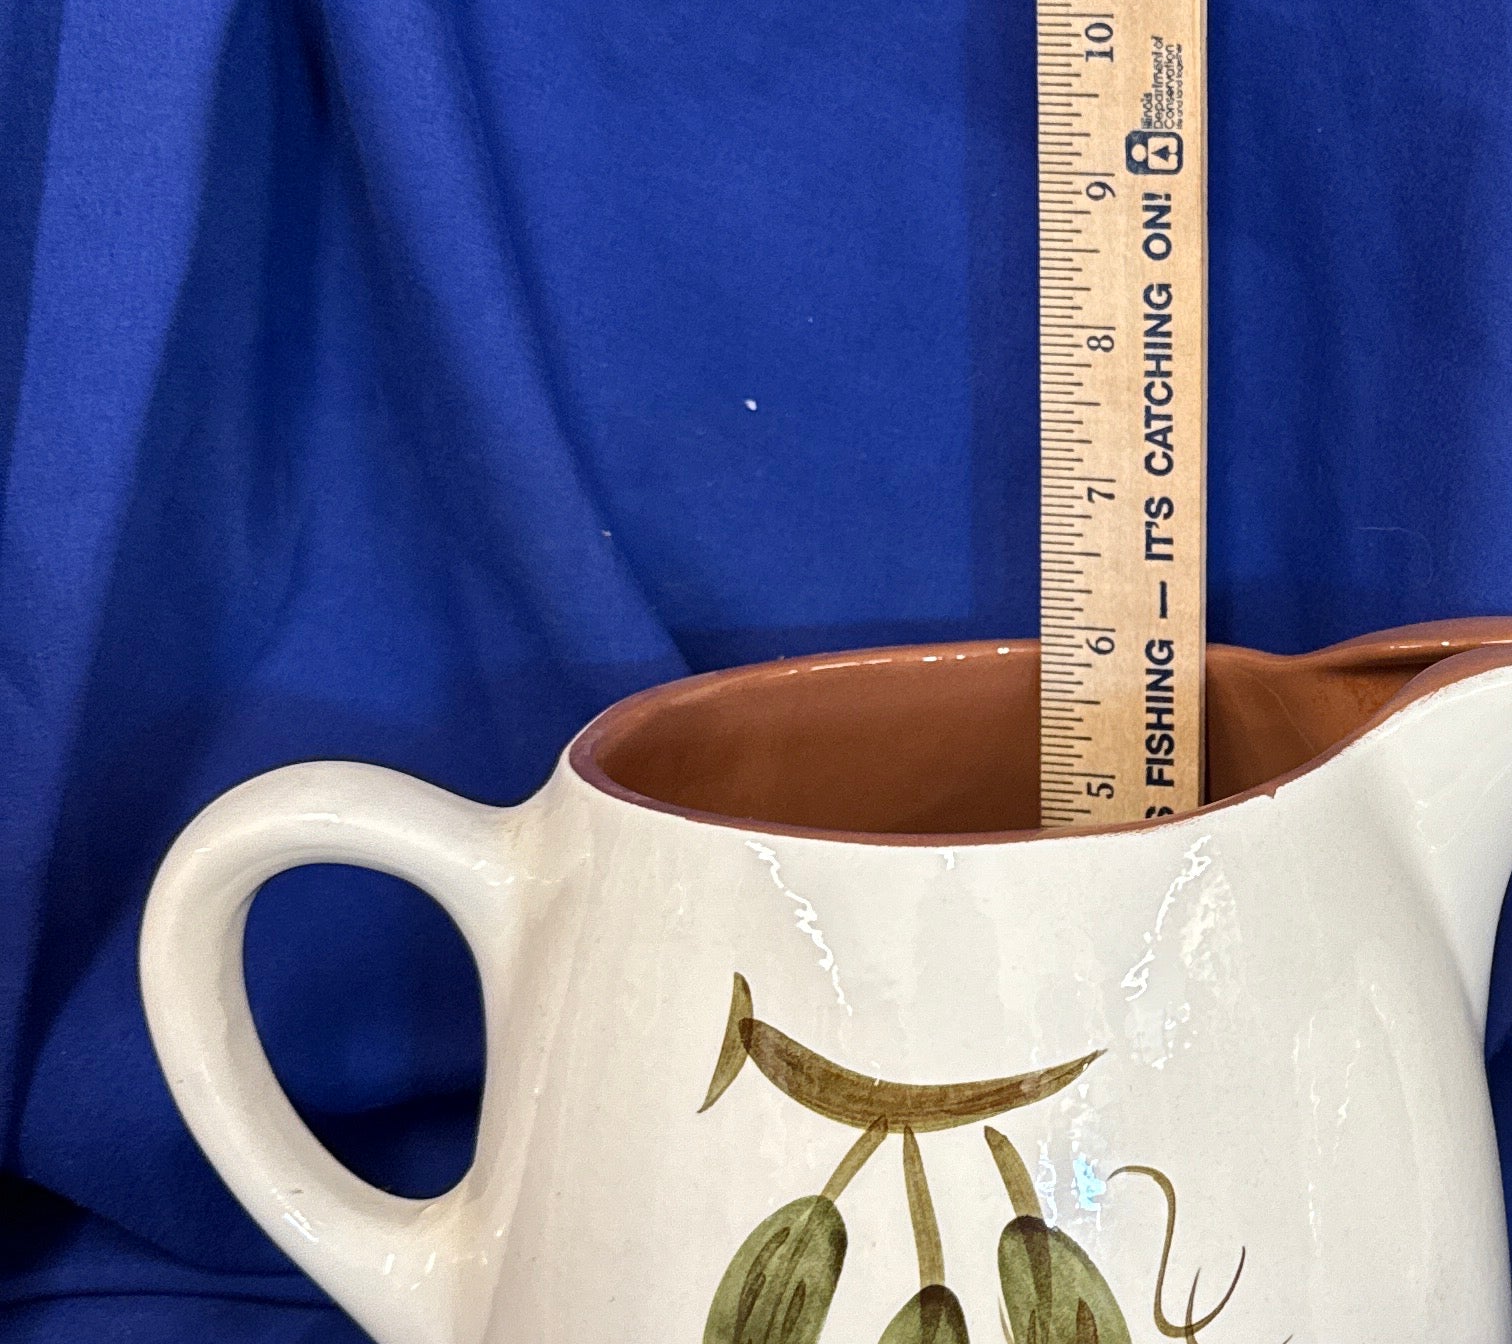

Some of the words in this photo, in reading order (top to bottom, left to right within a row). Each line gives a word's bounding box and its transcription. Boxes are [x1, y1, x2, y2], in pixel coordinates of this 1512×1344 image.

[1084, 22, 1114, 63] 10
[1151, 35, 1163, 49] of
[1151, 51, 1165, 129] Department
[1164, 44, 1175, 129] Conservation
[1085, 181, 1116, 201] 9
[1142, 192, 1172, 261] ON!
[1087, 334, 1115, 352] 8
[1143, 282, 1174, 476] CATCHING
[1086, 487, 1116, 504] 7
[1144, 496, 1174, 561] IT'S
[1086, 636, 1116, 655] 6
[1145, 639, 1174, 787] FISHING
[1086, 782, 1115, 799] 5
